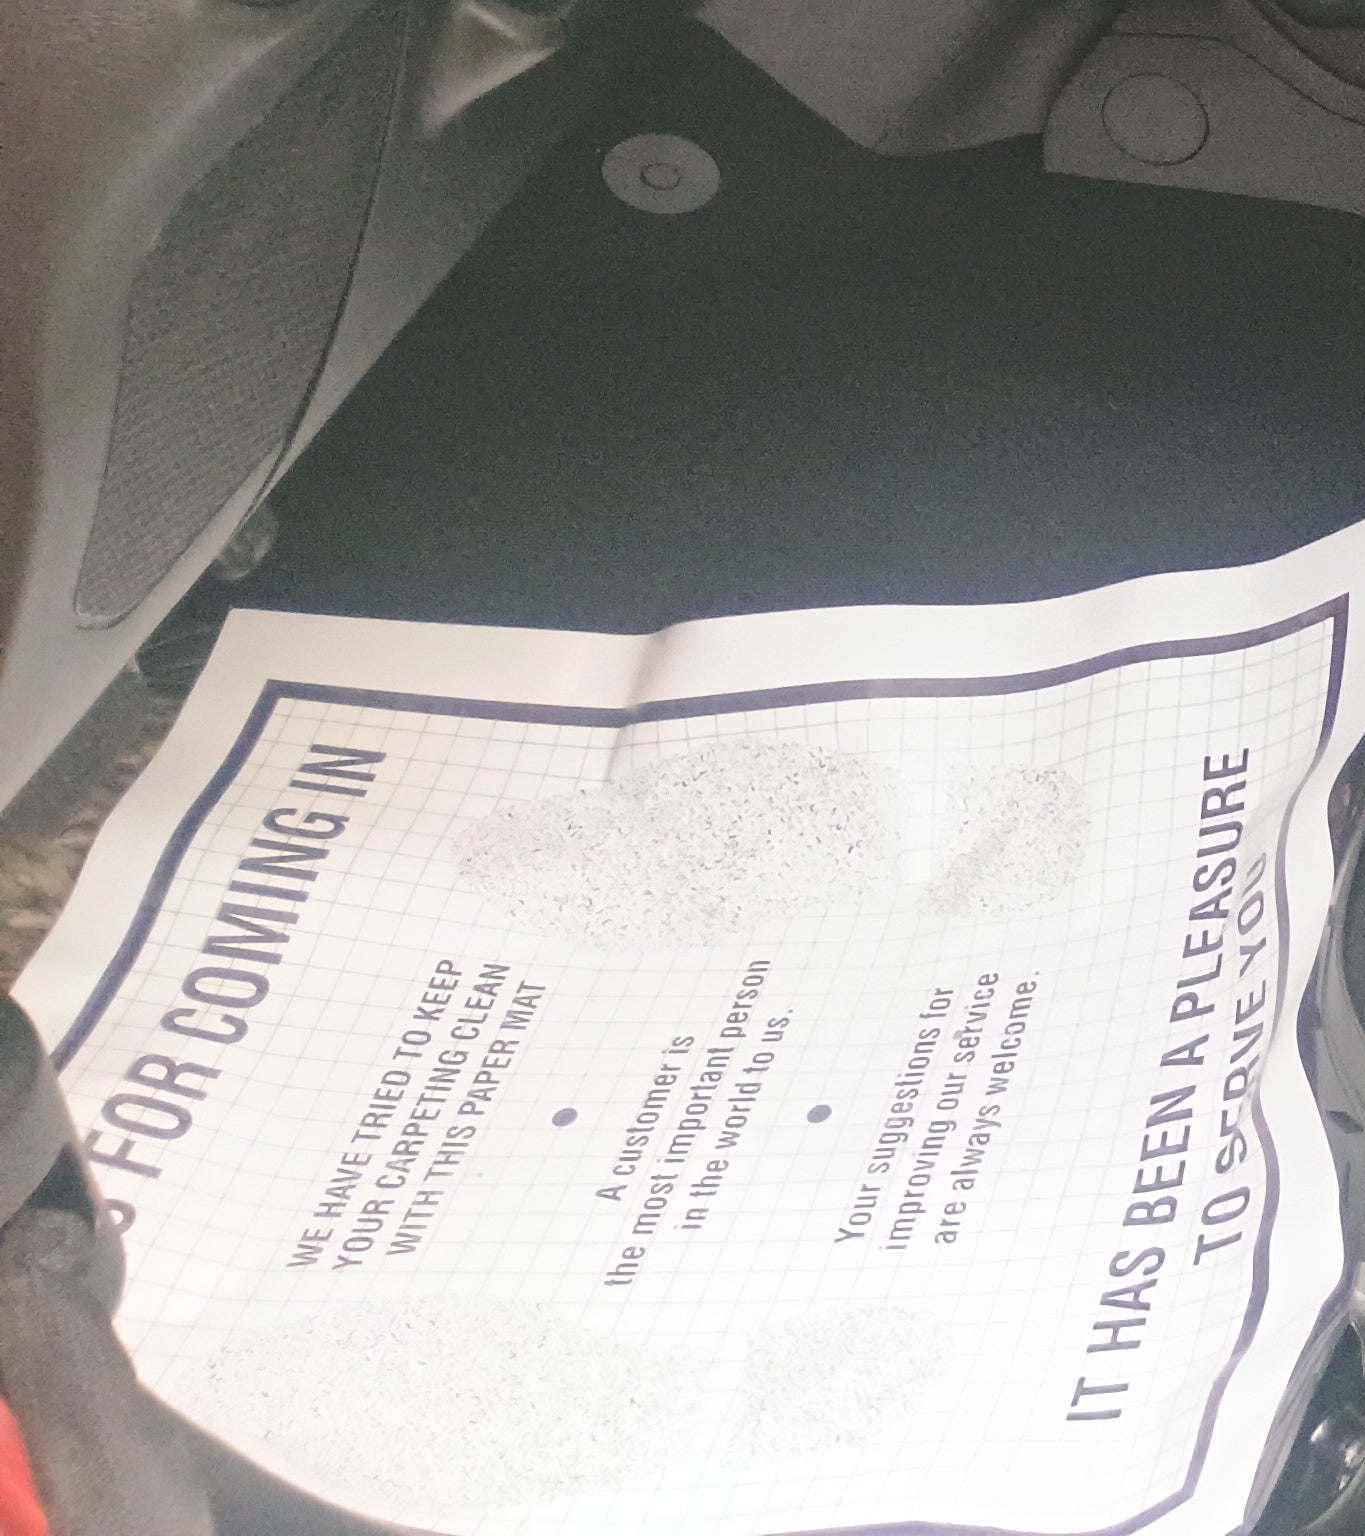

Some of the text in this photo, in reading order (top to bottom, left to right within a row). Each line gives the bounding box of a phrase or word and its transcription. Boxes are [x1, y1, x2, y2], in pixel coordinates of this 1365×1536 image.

[83, 744, 387, 1180] FOR COMING IN
[934, 970, 1040, 1244] are always welcome.
[1066, 748, 1249, 1421] IT HAS BEEN A PLEASURE
[1193, 1186, 1250, 1265] TO
[1237, 852, 1267, 978] YOU
[286, 959, 462, 1268] WE HAVE TRIED TO KEEP
[332, 963, 510, 1270] YOUR CARPETING CLEAN
[386, 980, 546, 1256] WITH THIS PAPER MAT
[595, 1035, 695, 1201] A customer is
[603, 960, 770, 1286] the most important person
[673, 1009, 794, 1229] in the world to us.
[833, 987, 953, 1243] Your suggestions for
[878, 971, 999, 1250] improving our service
